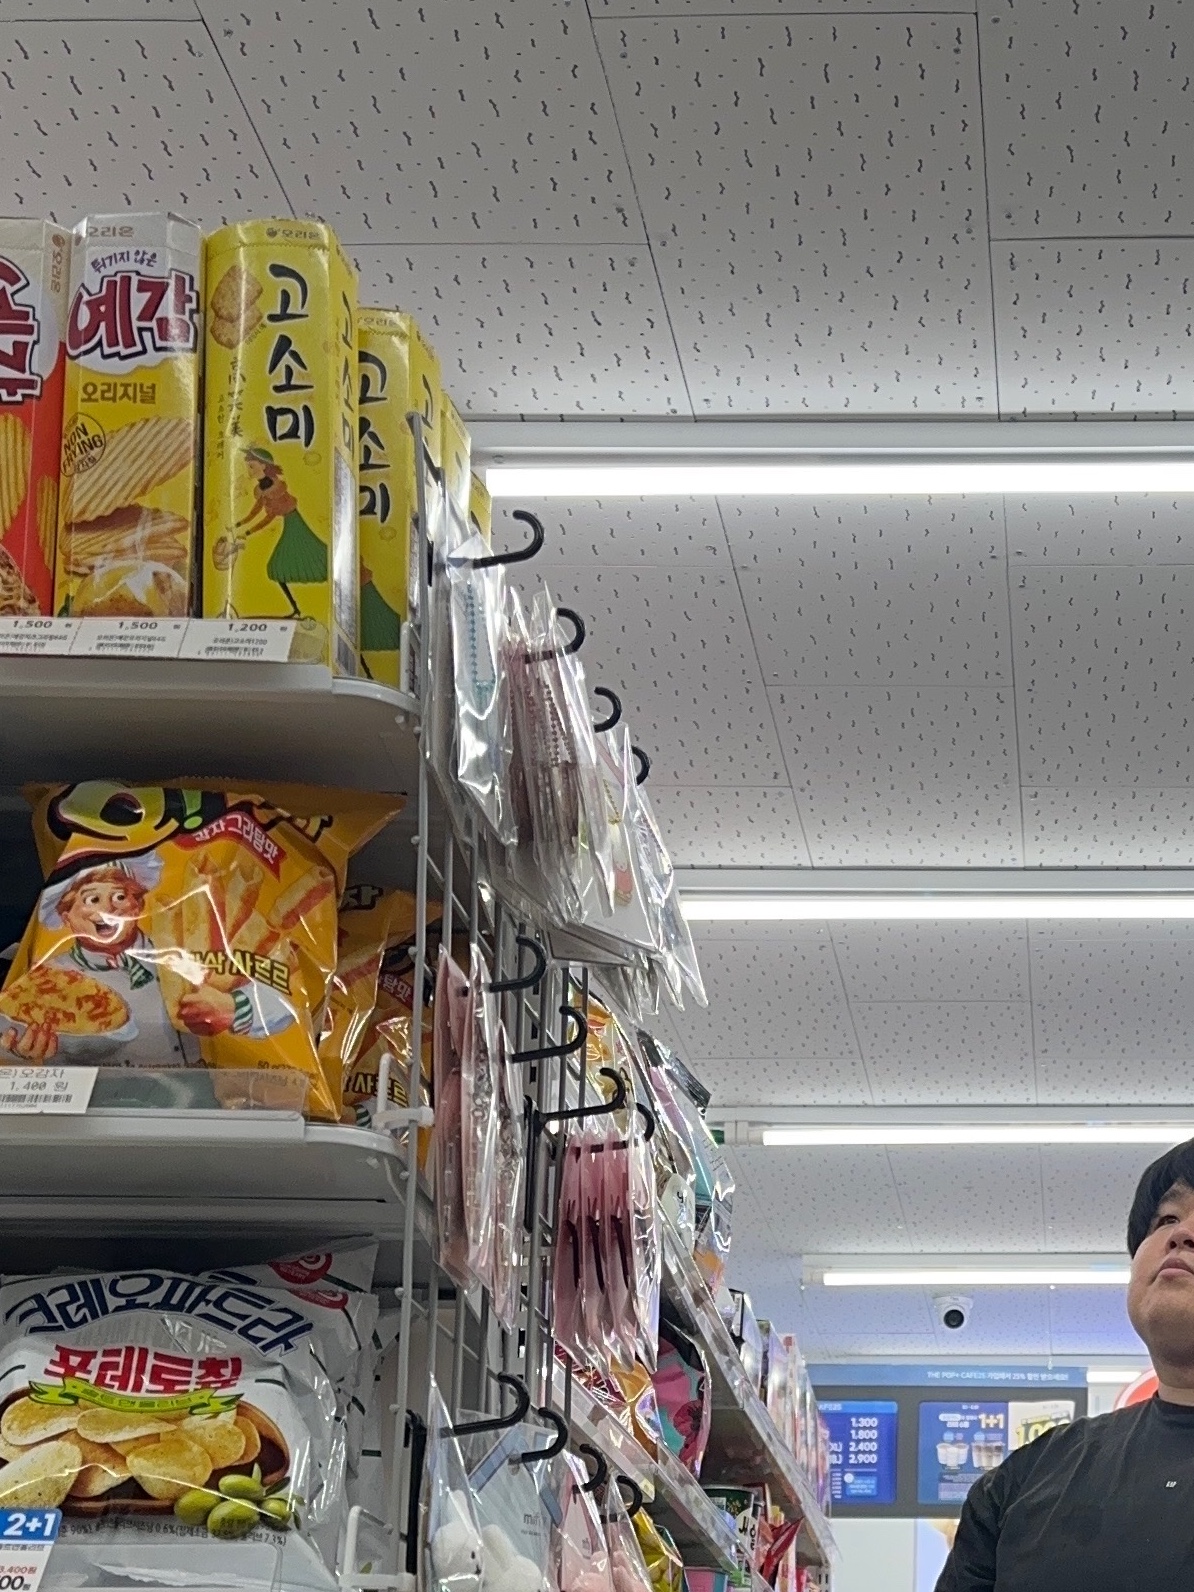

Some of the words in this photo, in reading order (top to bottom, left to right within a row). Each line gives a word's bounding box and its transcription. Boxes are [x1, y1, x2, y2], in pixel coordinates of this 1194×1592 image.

[91, 251, 130, 273] 튀기지
[67, 273, 194, 350] 예감
[265, 263, 316, 449] 고소미
[80, 381, 156, 405] 오리지널
[226, 809, 280, 865] 그라탕맛
[927, 1371, 941, 1379] THE
[978, 1412, 1005, 1429] 1+1
[3, 1513, 54, 1536] 2+1
